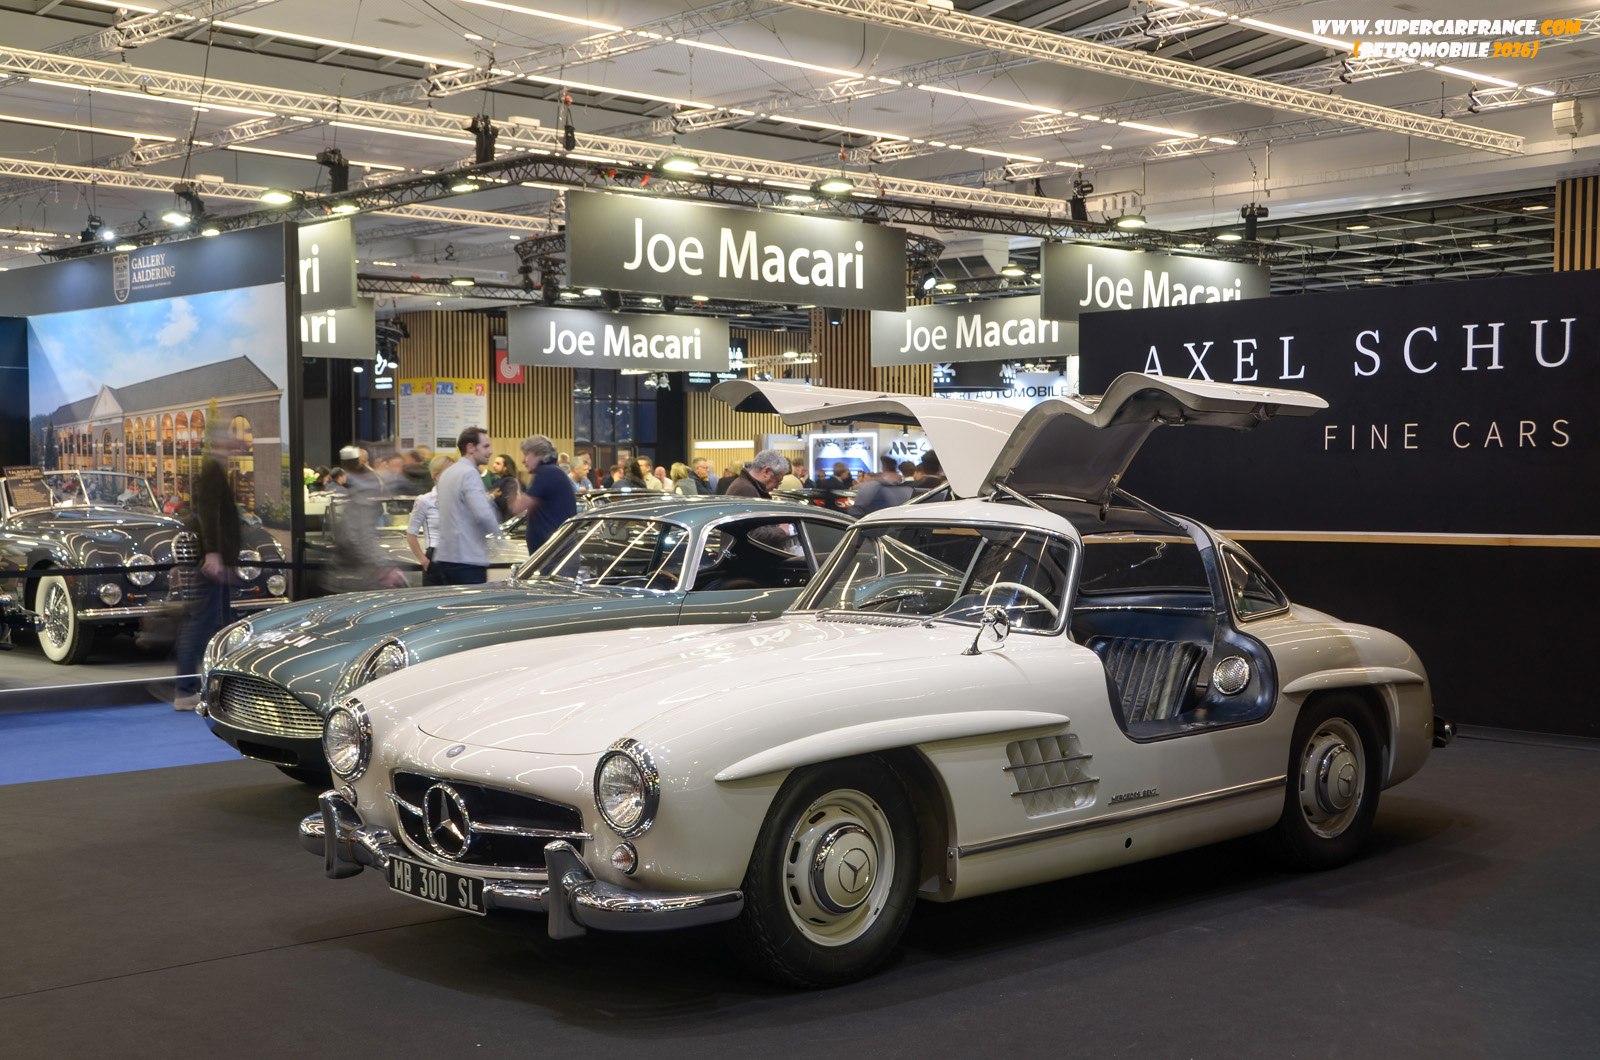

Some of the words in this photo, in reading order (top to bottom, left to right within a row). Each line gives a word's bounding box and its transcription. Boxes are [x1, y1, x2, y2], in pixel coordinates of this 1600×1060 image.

[131, 253, 166, 270] GALLERY
[623, 217, 705, 277] Joe
[718, 227, 864, 290] Macari
[131, 265, 176, 284] AALDERING
[1079, 263, 1134, 311] Joe
[1143, 269, 1242, 309] Macari
[542, 320, 596, 356] Joe
[603, 324, 702, 360] Macari
[899, 319, 948, 353] Joe
[955, 313, 1059, 349] Macari
[1143, 335, 1306, 383] AXEL
[1354, 317, 1577, 377] SCHU
[1324, 423, 1419, 450] FINE
[1452, 419, 1569, 448] CARS
[394, 859, 412, 892] MB
[419, 867, 447, 902] 300
[458, 877, 478, 910] SL
